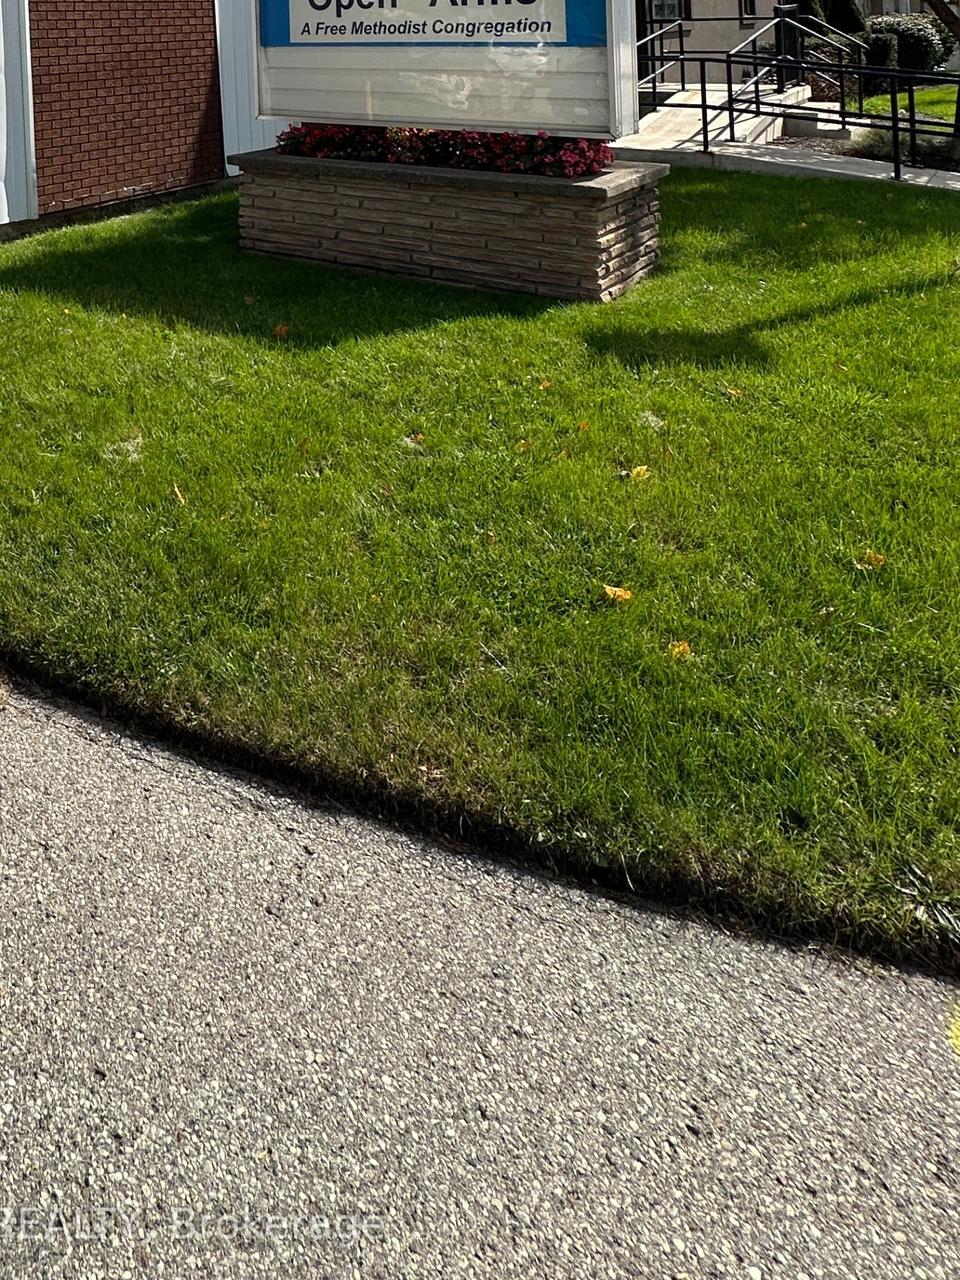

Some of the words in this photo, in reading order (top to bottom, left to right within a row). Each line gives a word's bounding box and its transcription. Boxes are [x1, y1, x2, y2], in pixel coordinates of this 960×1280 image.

[301, 22, 311, 35] A
[315, 22, 347, 35] Free
[351, 20, 428, 35] Methodist
[432, 18, 552, 37] Congregation
